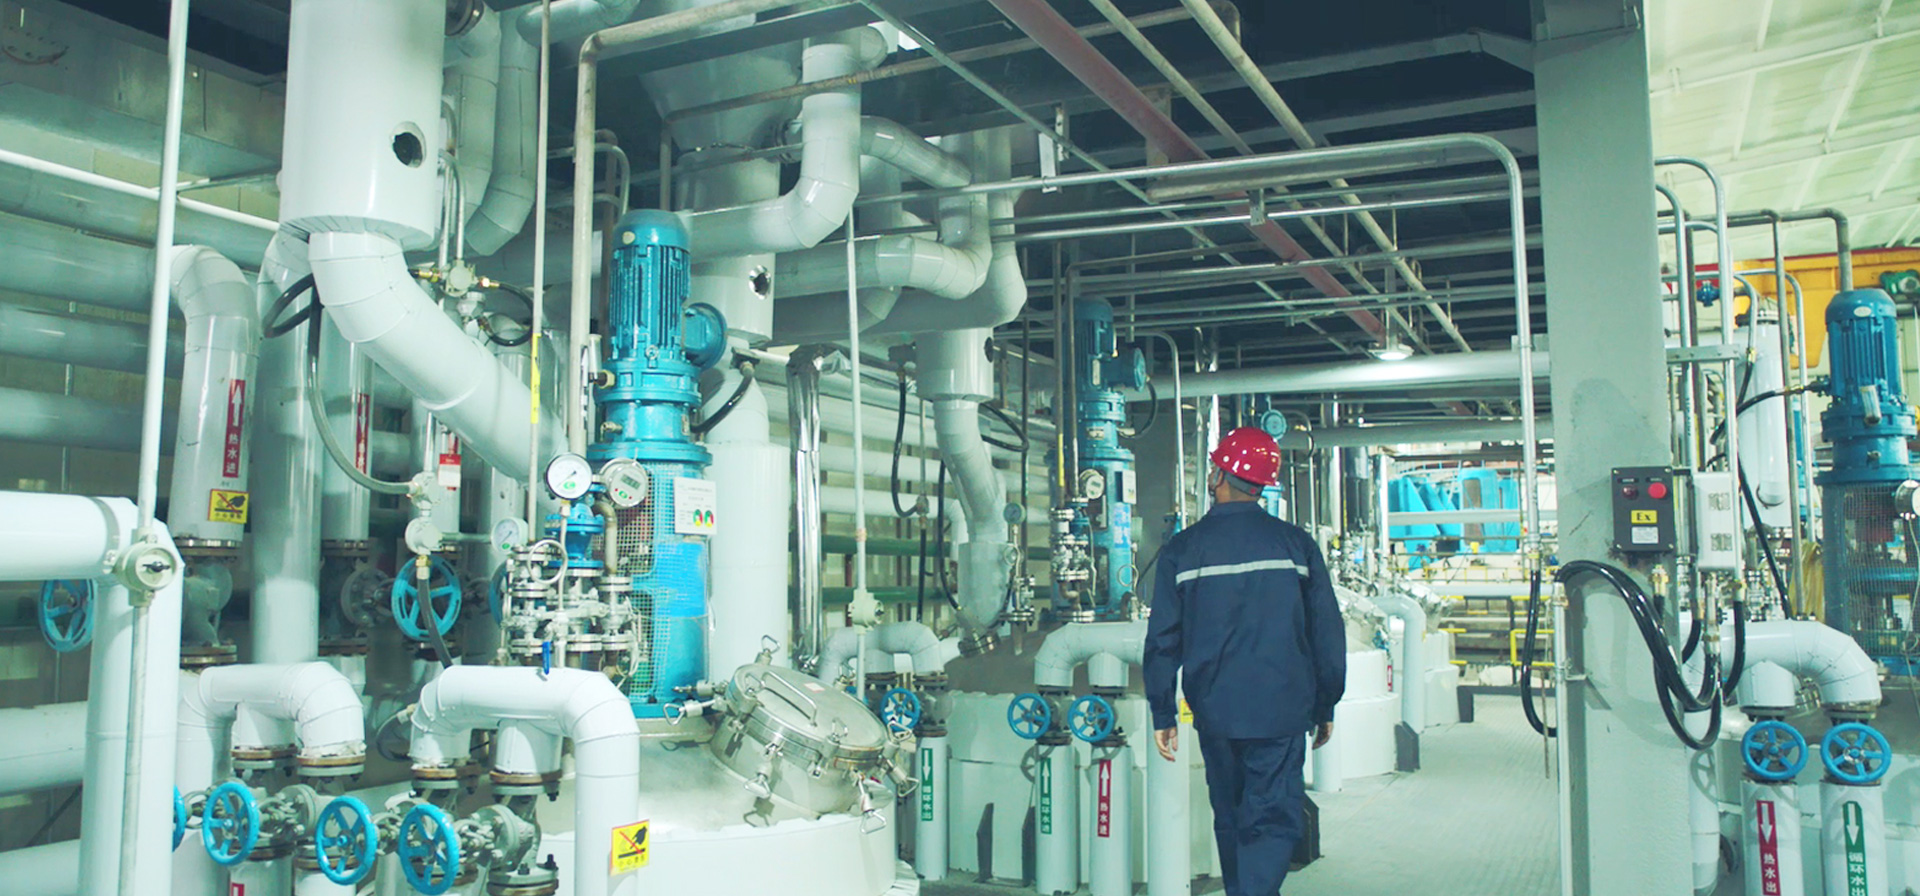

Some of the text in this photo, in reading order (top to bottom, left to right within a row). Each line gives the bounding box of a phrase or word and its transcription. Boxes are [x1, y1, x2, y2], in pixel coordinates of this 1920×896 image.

[226, 433, 239, 474] 热水进
[1636, 512, 1651, 521] Ex
[1763, 852, 1777, 893] 热水出
